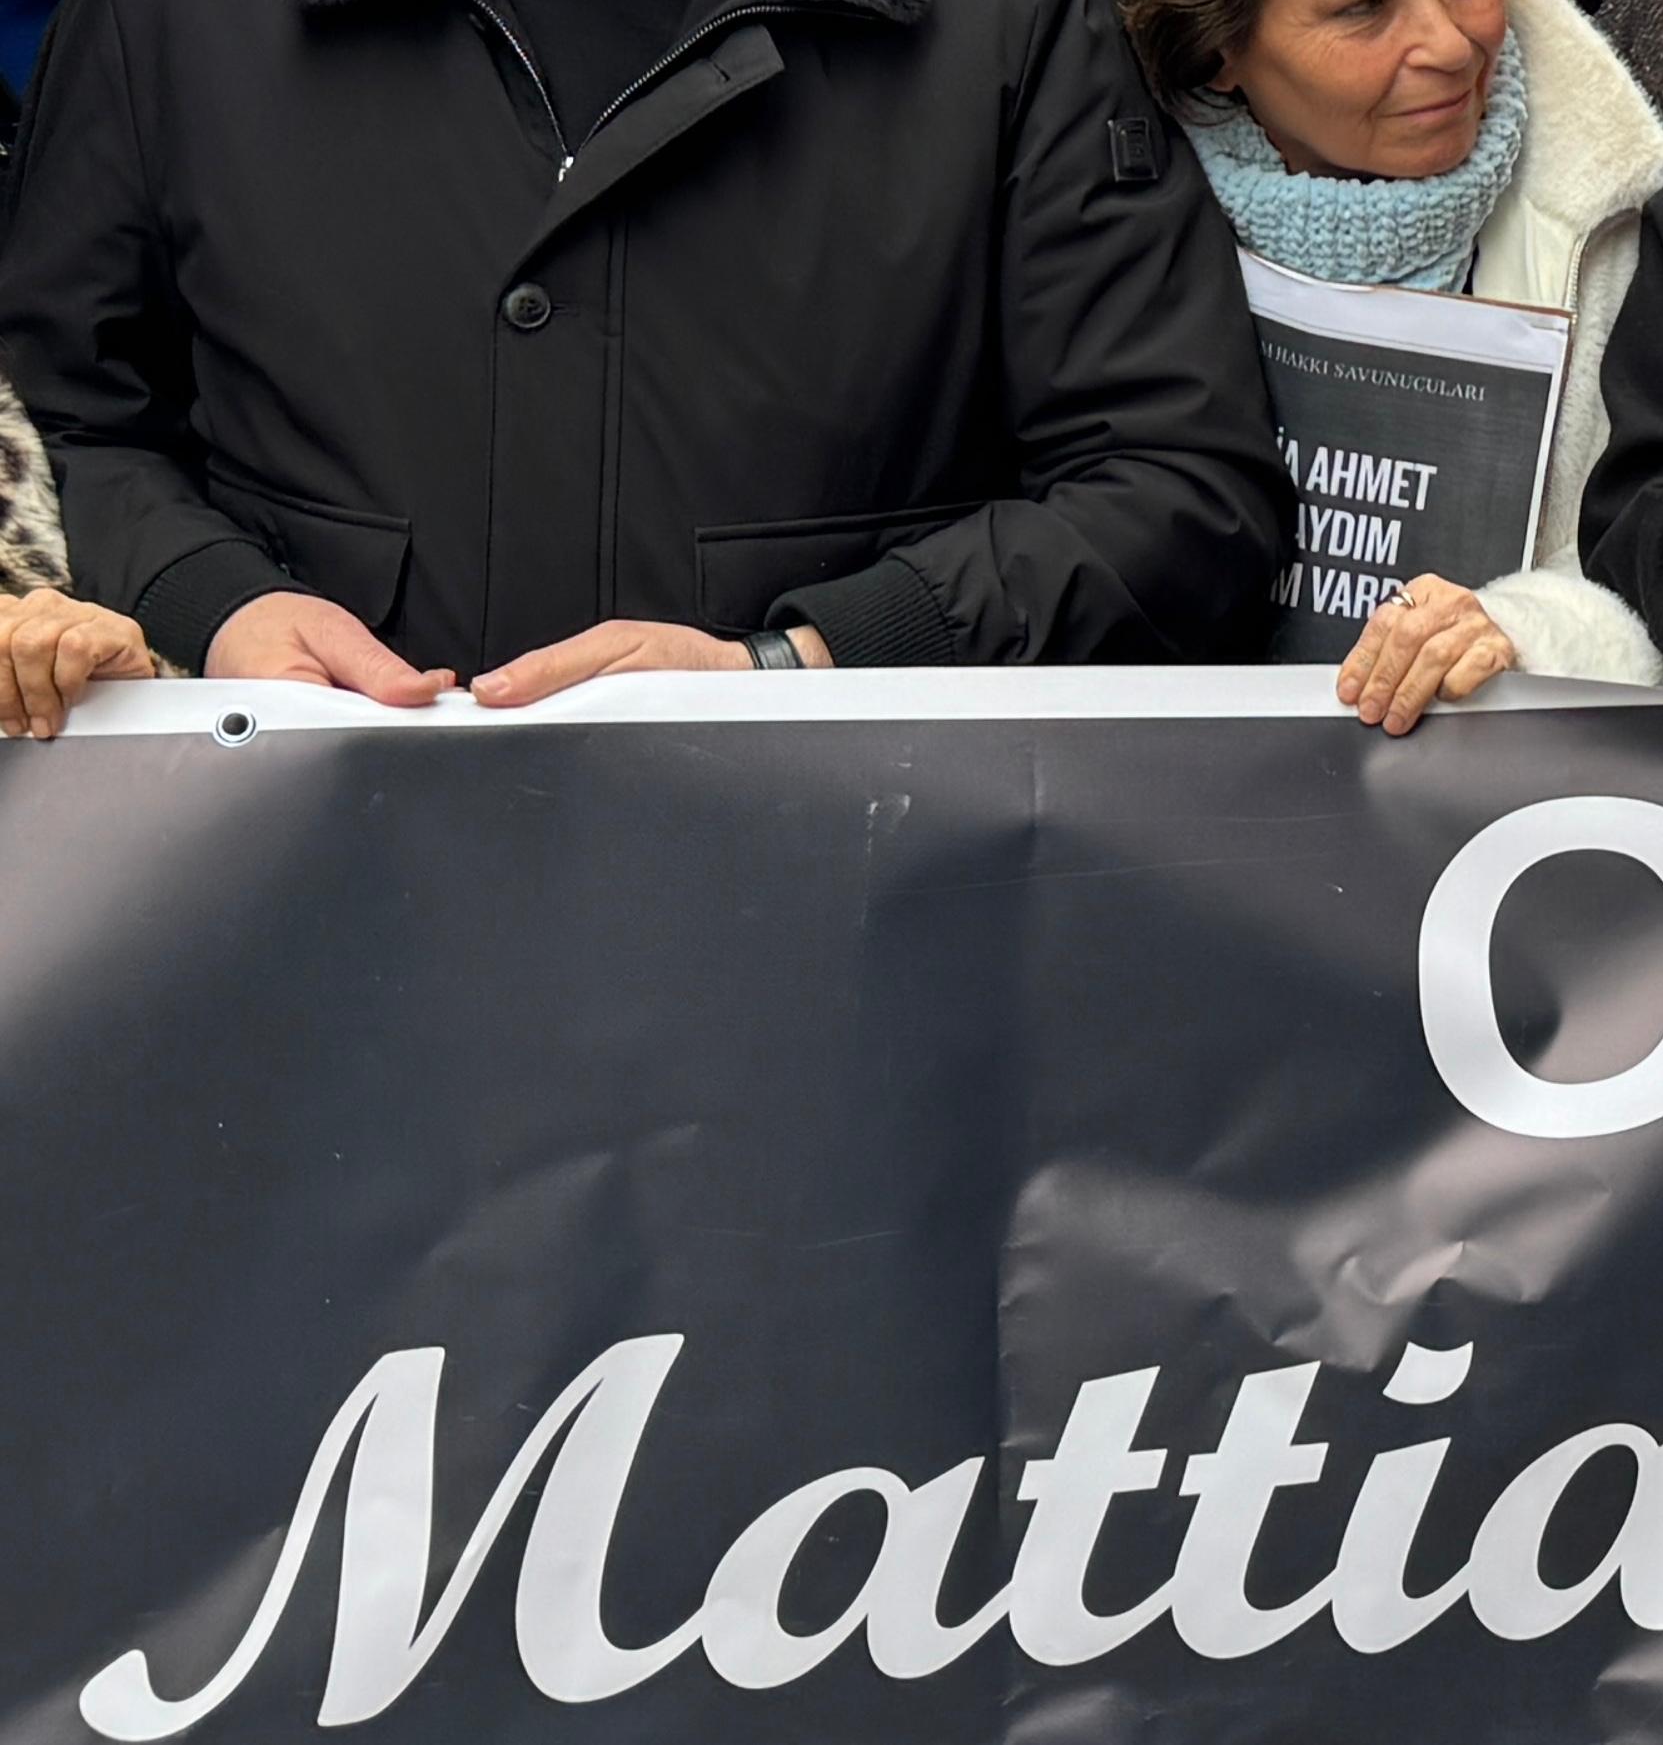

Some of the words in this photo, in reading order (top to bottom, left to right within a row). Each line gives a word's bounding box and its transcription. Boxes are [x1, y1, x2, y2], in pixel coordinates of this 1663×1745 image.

[1275, 346, 1328, 374] HAKKI
[1333, 362, 1487, 402] SAVUNUCULARI
[1305, 446, 1438, 511] AHMET
